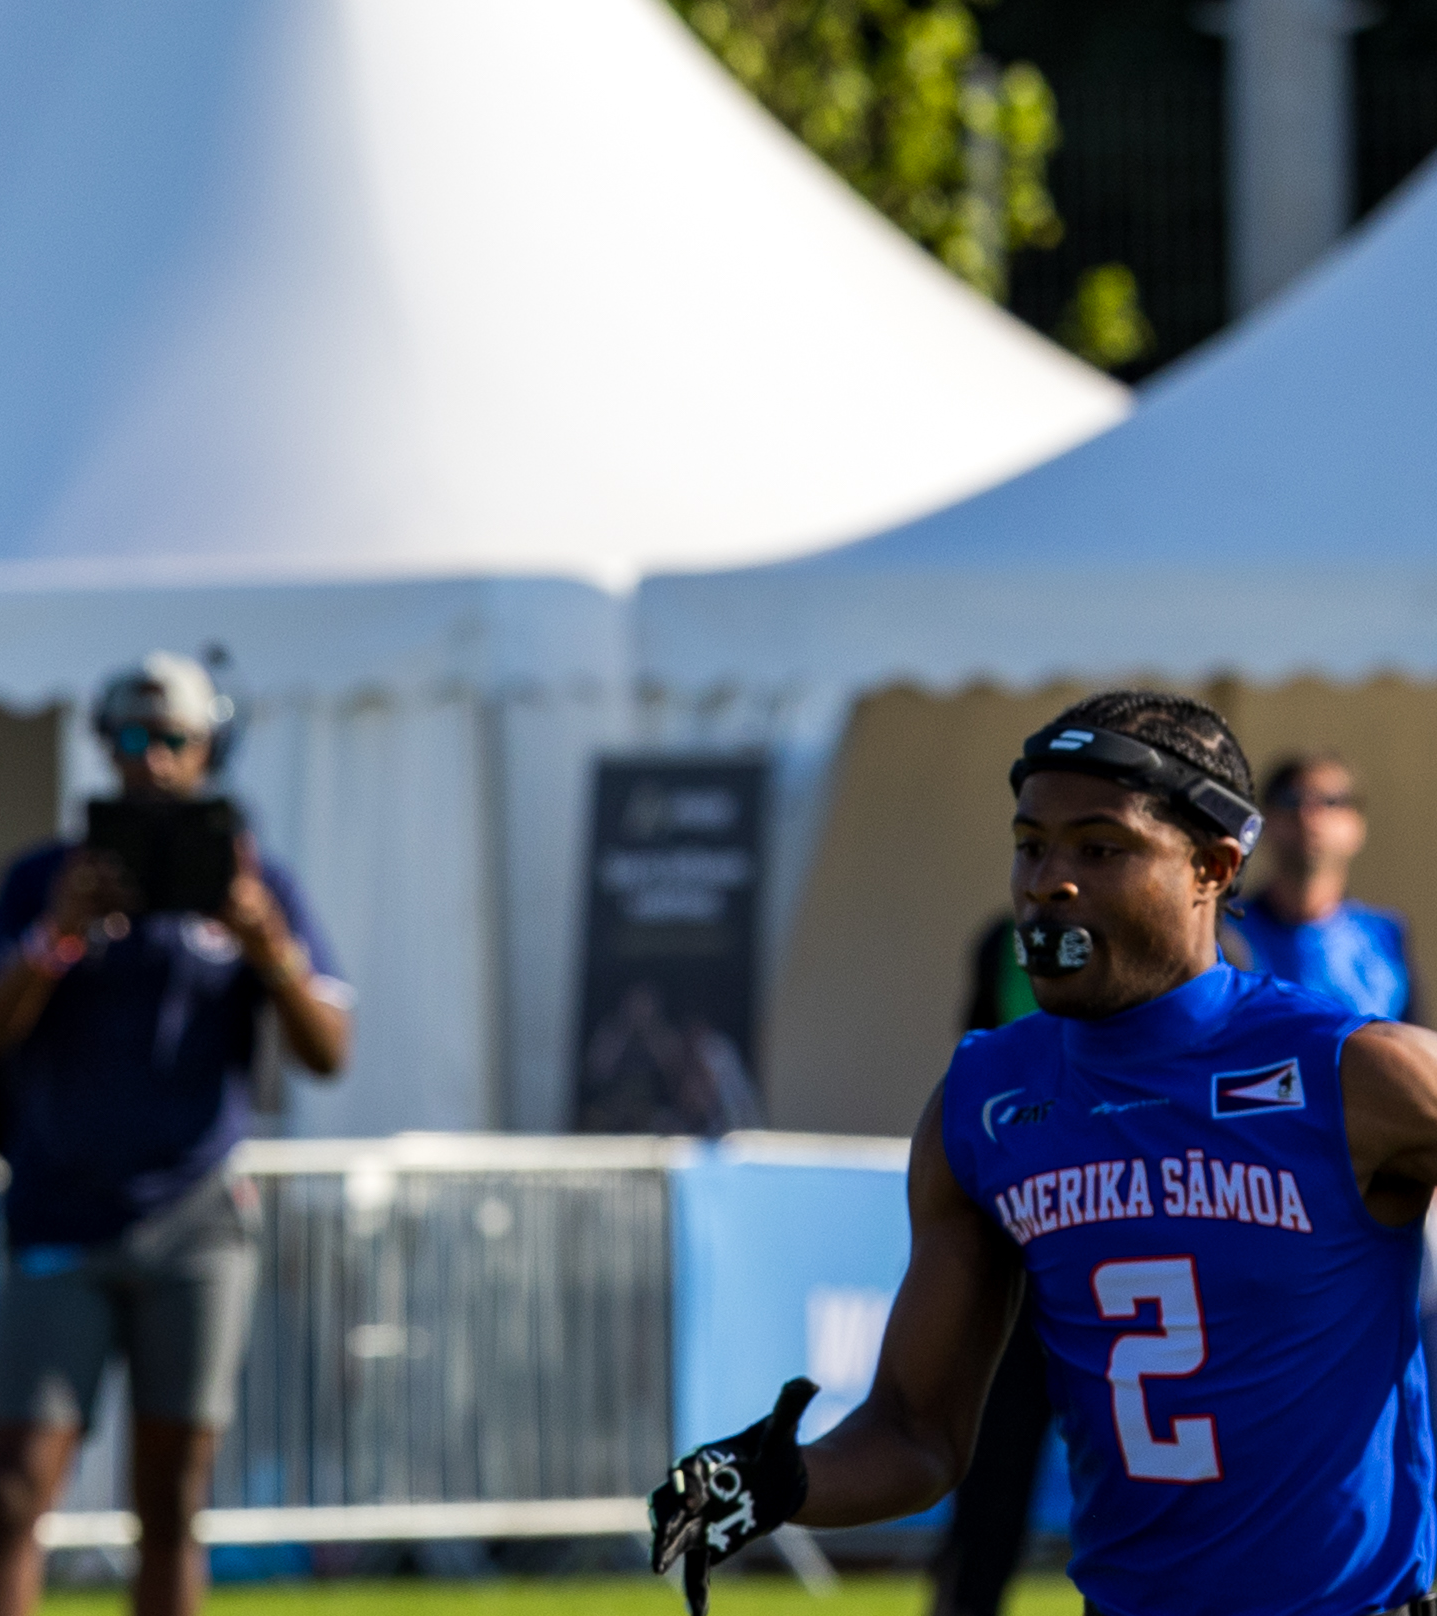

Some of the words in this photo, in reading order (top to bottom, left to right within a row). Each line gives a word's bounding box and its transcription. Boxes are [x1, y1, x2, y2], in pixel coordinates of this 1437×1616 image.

[995, 1158, 1154, 1246] AMERIKA
[1160, 1149, 1313, 1233] SĀMOA
[1089, 1253, 1225, 1484] 2
